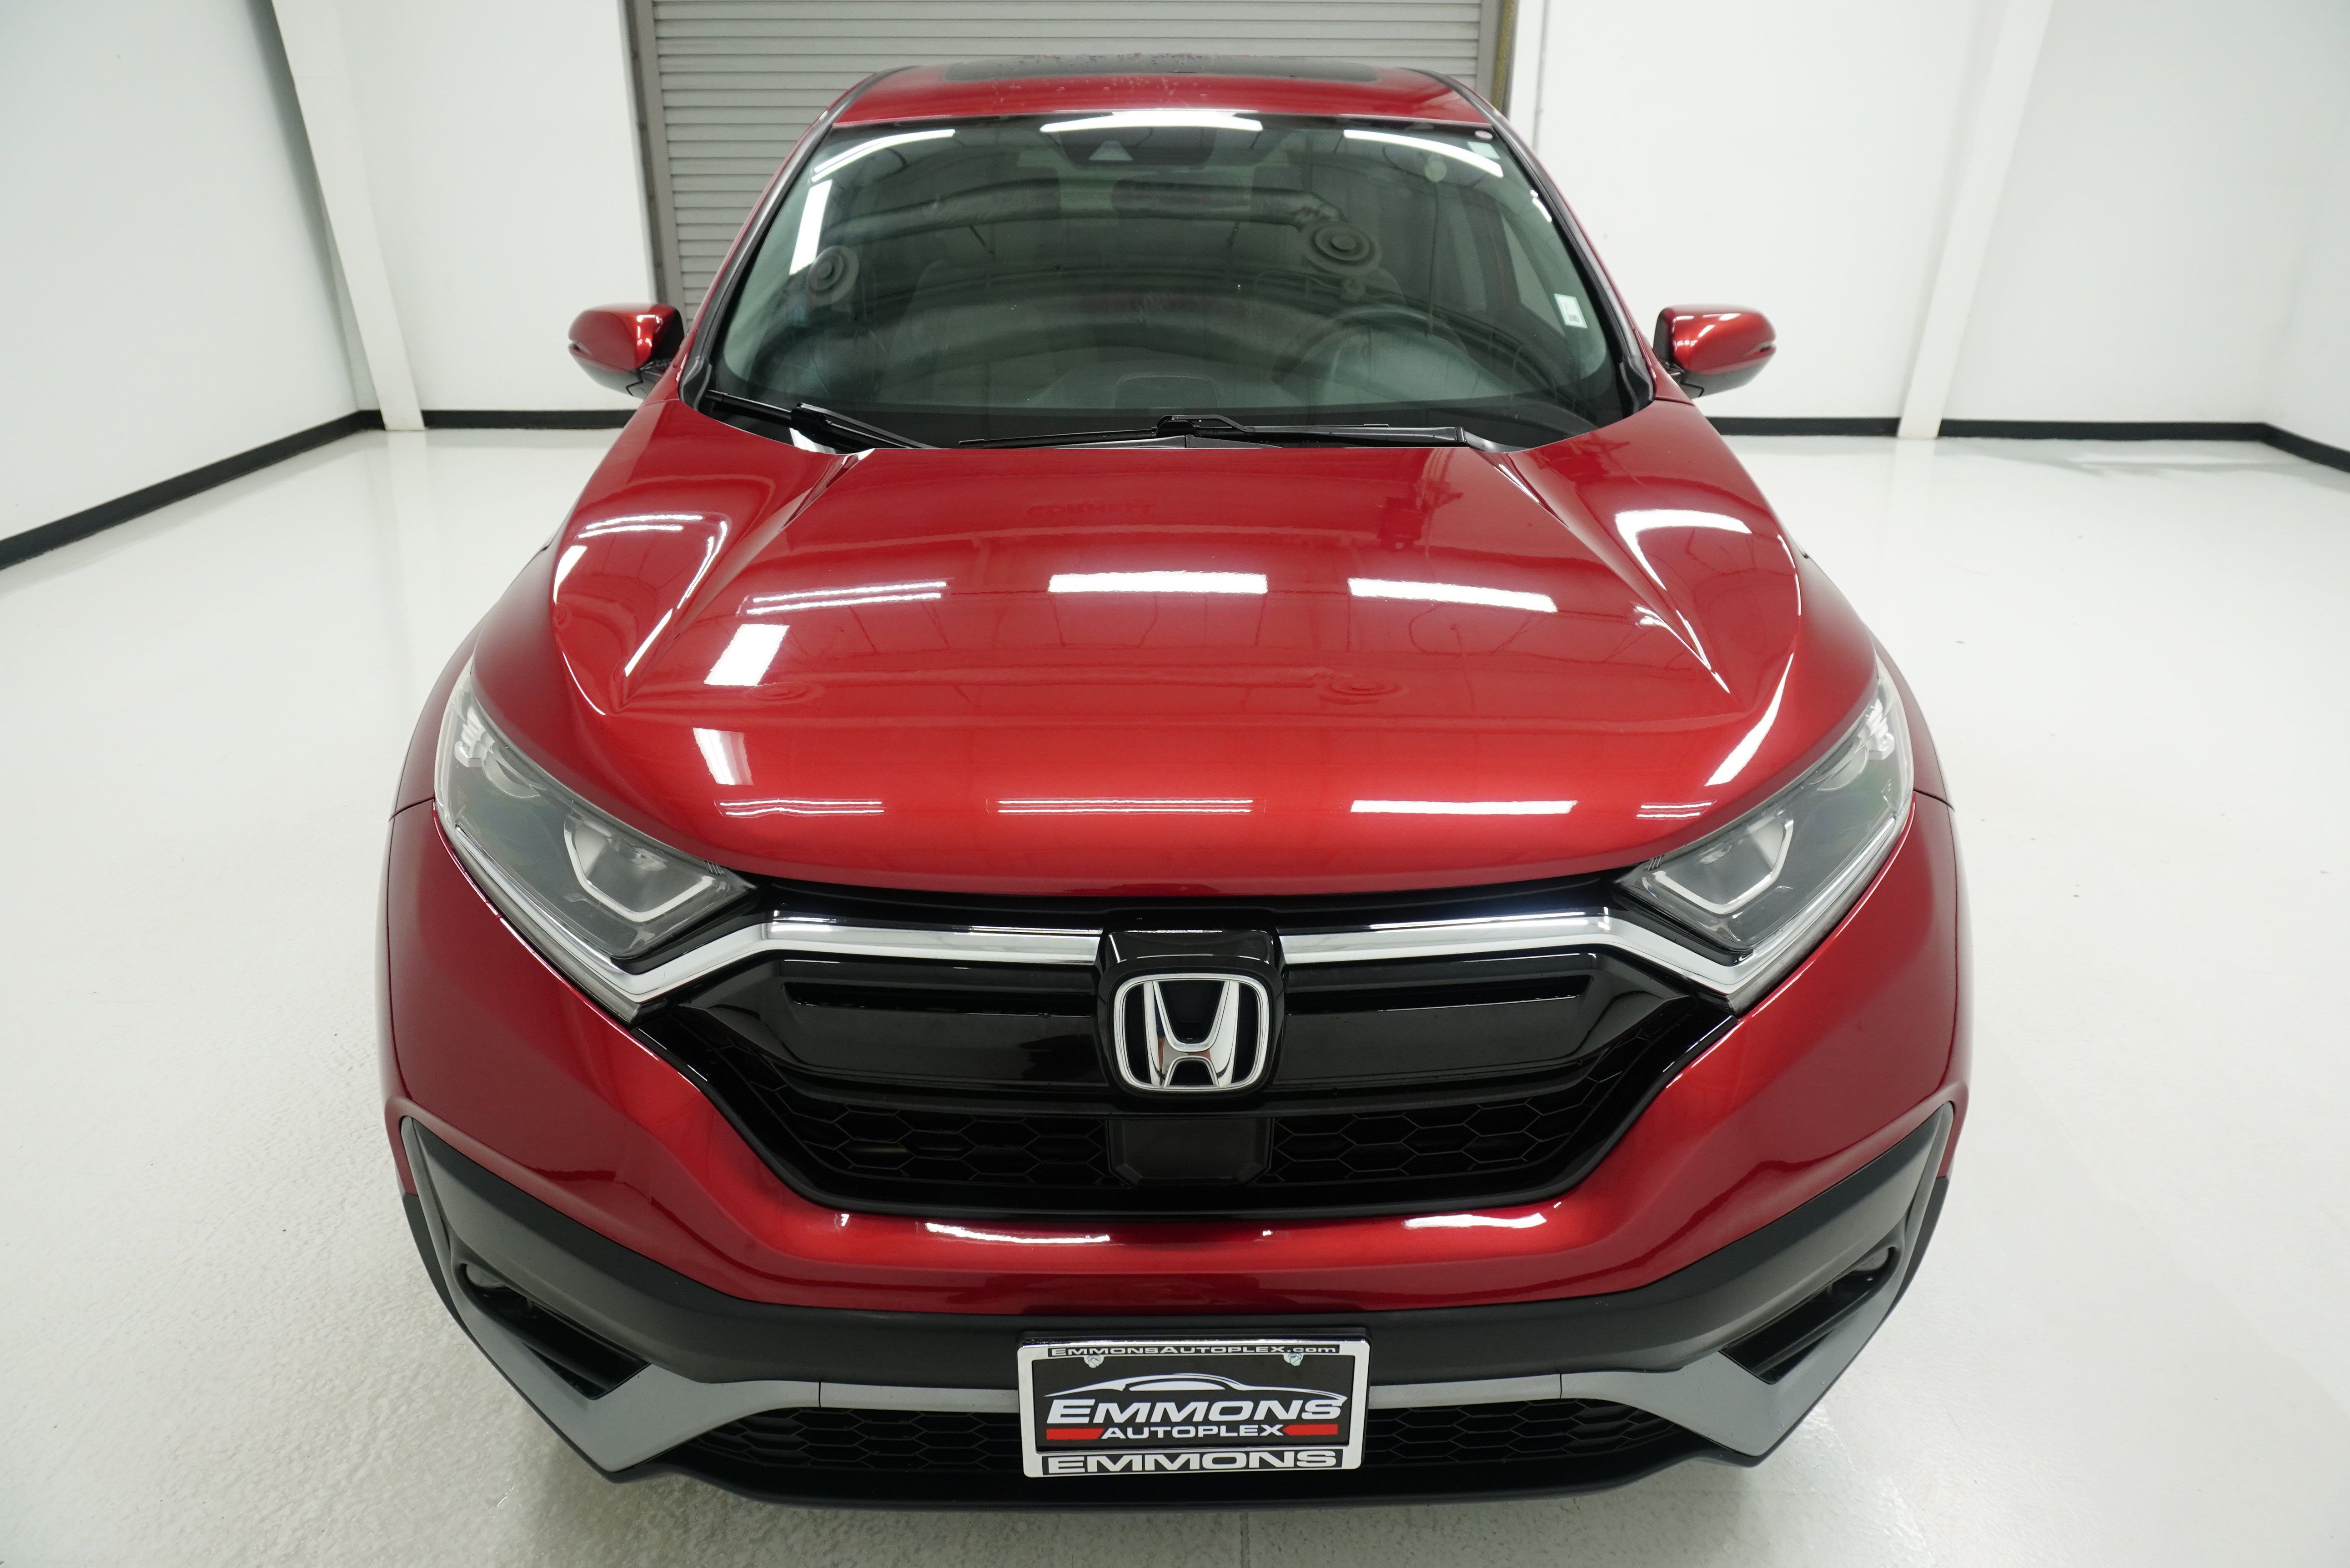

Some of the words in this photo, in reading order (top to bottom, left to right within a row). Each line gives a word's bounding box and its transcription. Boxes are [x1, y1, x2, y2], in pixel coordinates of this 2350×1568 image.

[1046, 1399, 1345, 1424] EMMONS
[1100, 1424, 1284, 1440] AUTOPLEX
[1047, 1450, 1336, 1474] EMMONS
